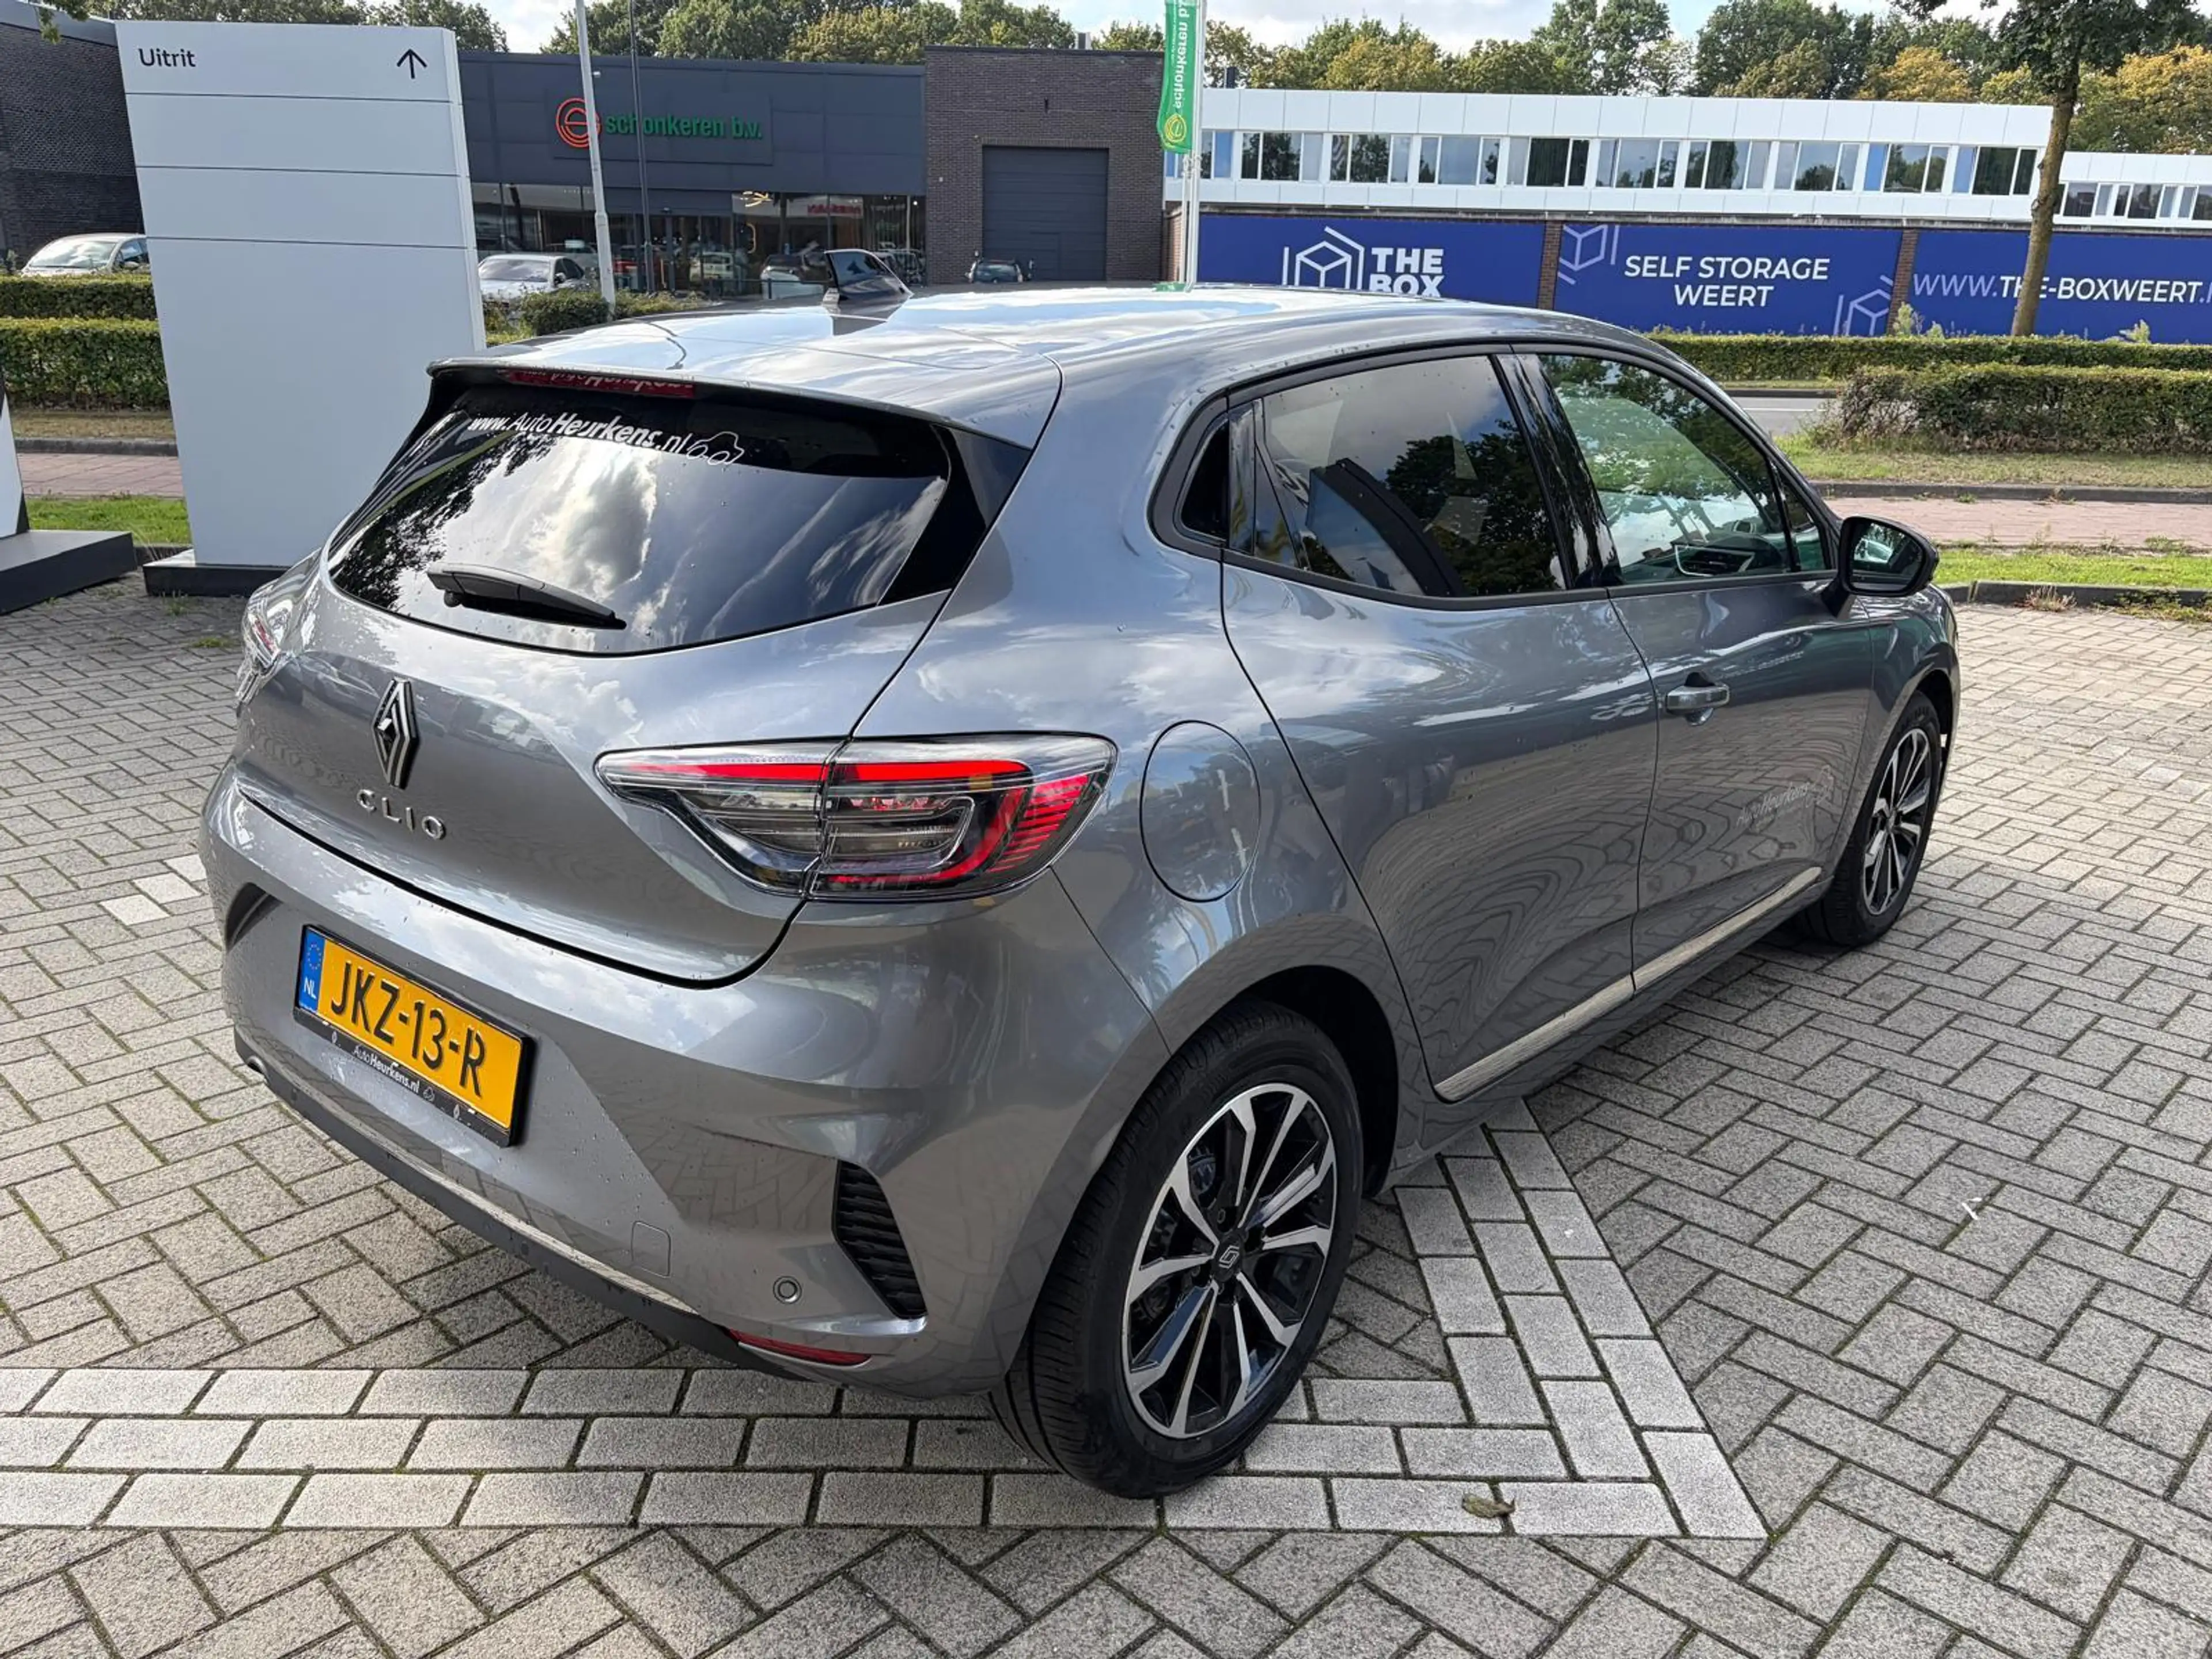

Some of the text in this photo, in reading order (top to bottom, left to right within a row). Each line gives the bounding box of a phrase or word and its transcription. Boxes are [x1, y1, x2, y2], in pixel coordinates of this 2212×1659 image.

[138, 48, 196, 67] Uitrit
[731, 116, 762, 138] b.v.
[1370, 248, 1444, 274] THE
[1624, 255, 1830, 281] SELF STORAGE
[1369, 273, 1445, 298] BOX
[1674, 284, 1775, 308] WEERT
[467, 412, 694, 454] www.AutoHeurkens.nl
[357, 789, 446, 840] CLIO
[304, 976, 317, 1001] NL
[330, 960, 487, 1099] JKZ-13-R
